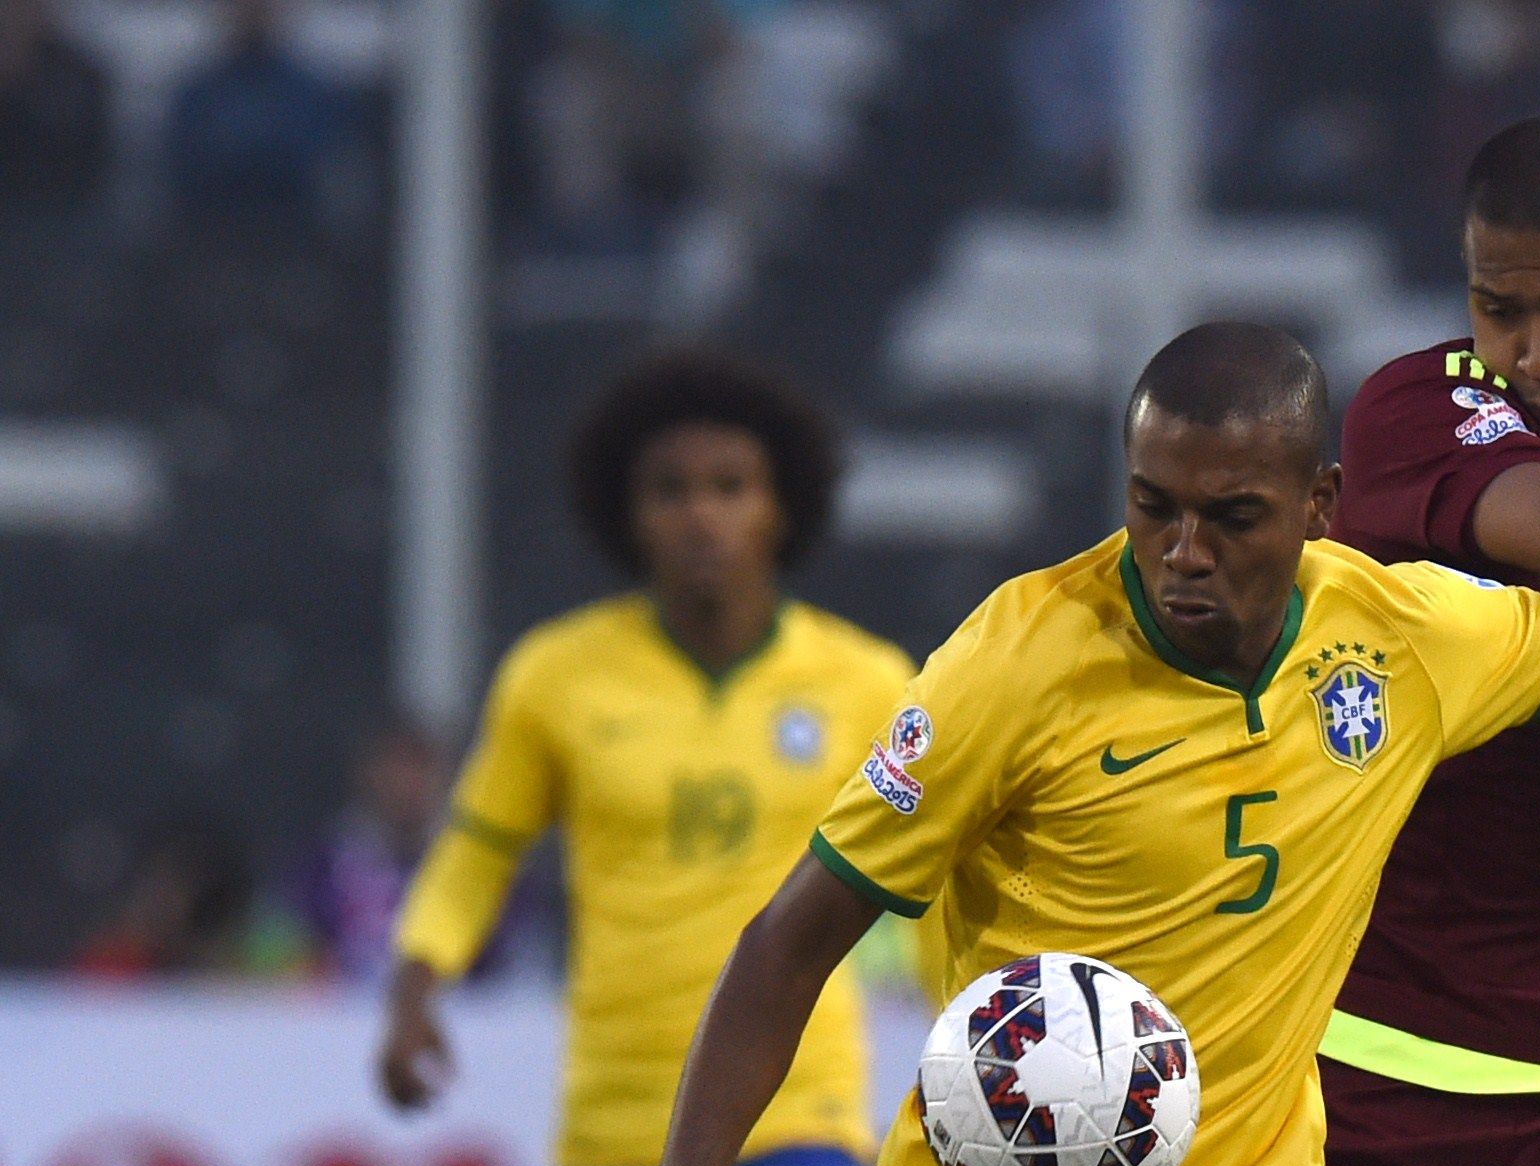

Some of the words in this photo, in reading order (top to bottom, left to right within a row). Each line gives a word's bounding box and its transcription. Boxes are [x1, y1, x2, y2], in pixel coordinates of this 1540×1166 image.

[1458, 413, 1486, 435] COPA
[1341, 703, 1367, 720] CBF
[886, 780, 917, 812] 2015
[669, 772, 757, 862] 19
[1214, 789, 1280, 915] 5
